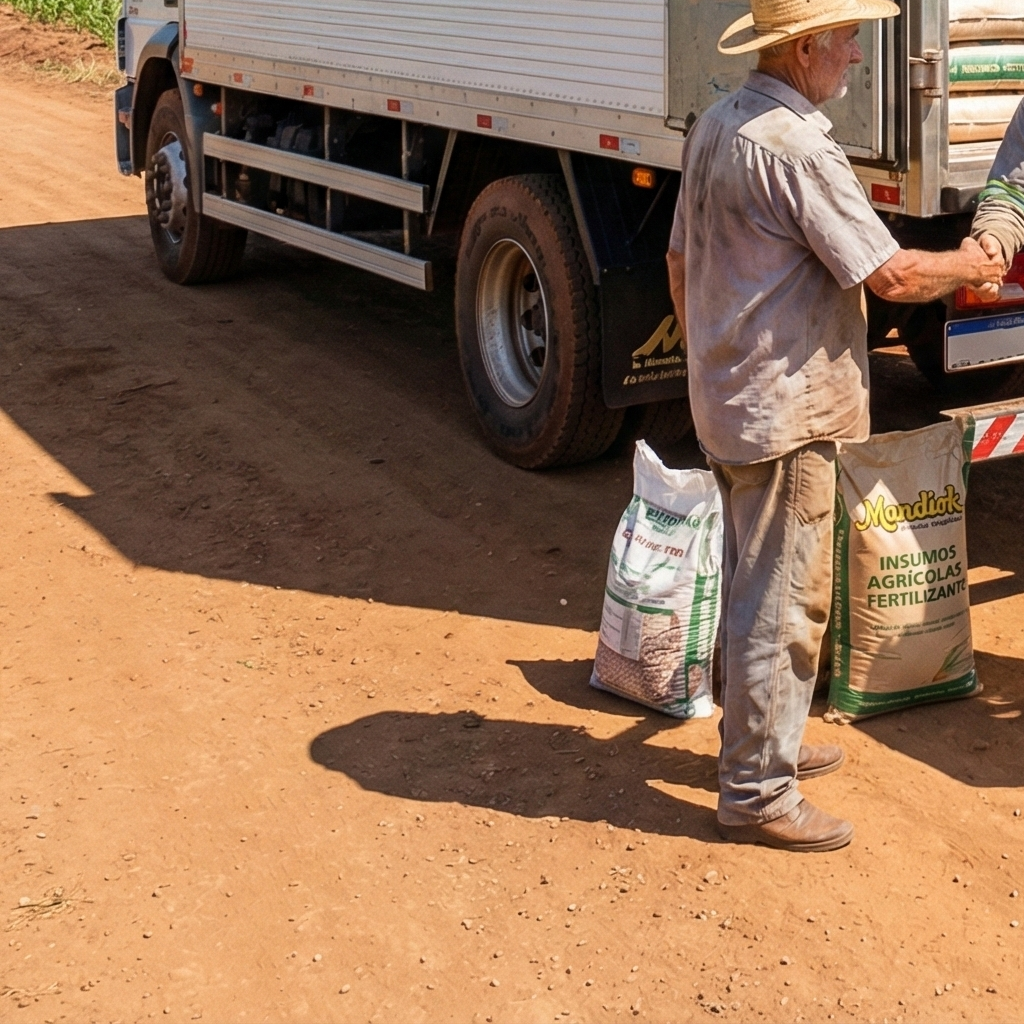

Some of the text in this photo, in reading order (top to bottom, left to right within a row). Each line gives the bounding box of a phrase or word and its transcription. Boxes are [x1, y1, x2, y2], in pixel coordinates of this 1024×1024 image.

[854, 484, 964, 533] Mandiok
[880, 544, 957, 571] INSUMOS
[867, 561, 962, 590] AGRÍCOLAS
